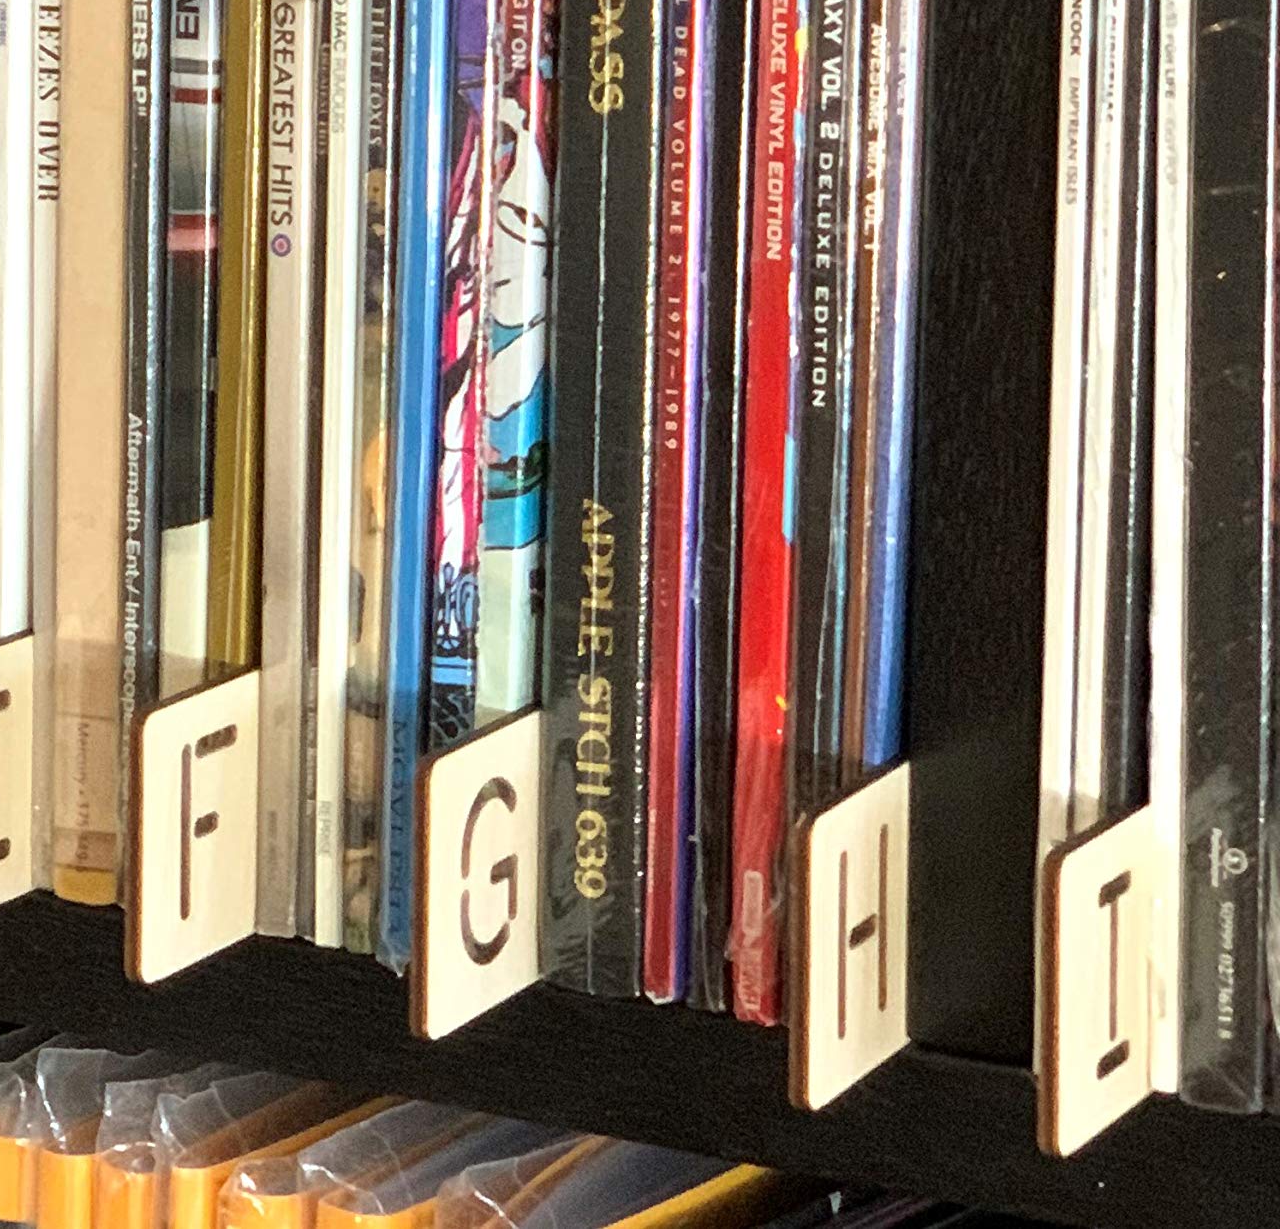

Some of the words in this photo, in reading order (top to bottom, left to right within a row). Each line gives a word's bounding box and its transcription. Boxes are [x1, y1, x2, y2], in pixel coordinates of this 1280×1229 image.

[334, 11, 347, 51] MAC
[510, 41, 527, 70] ON
[512, 15, 528, 34] IT
[273, 2, 296, 153] GREATEST
[768, 82, 786, 154] VINYL
[821, 57, 841, 110] VOL.
[1066, 77, 1081, 159] EMPYREAN
[38, 121, 60, 201] OVER
[821, 122, 839, 138] 2
[271, 165, 292, 226] HITS
[766, 161, 784, 260] EDITION
[816, 152, 835, 268] DELUXE
[1066, 166, 1078, 205] ISLES
[812, 286, 830, 408] EDITION
[577, 499, 615, 657] APPLE
[575, 674, 612, 796] STCH
[181, 724, 238, 921] F
[574, 810, 608, 899] 639
[461, 777, 518, 965] G
[838, 824, 889, 1040] H
[1096, 869, 1131, 1081] I
